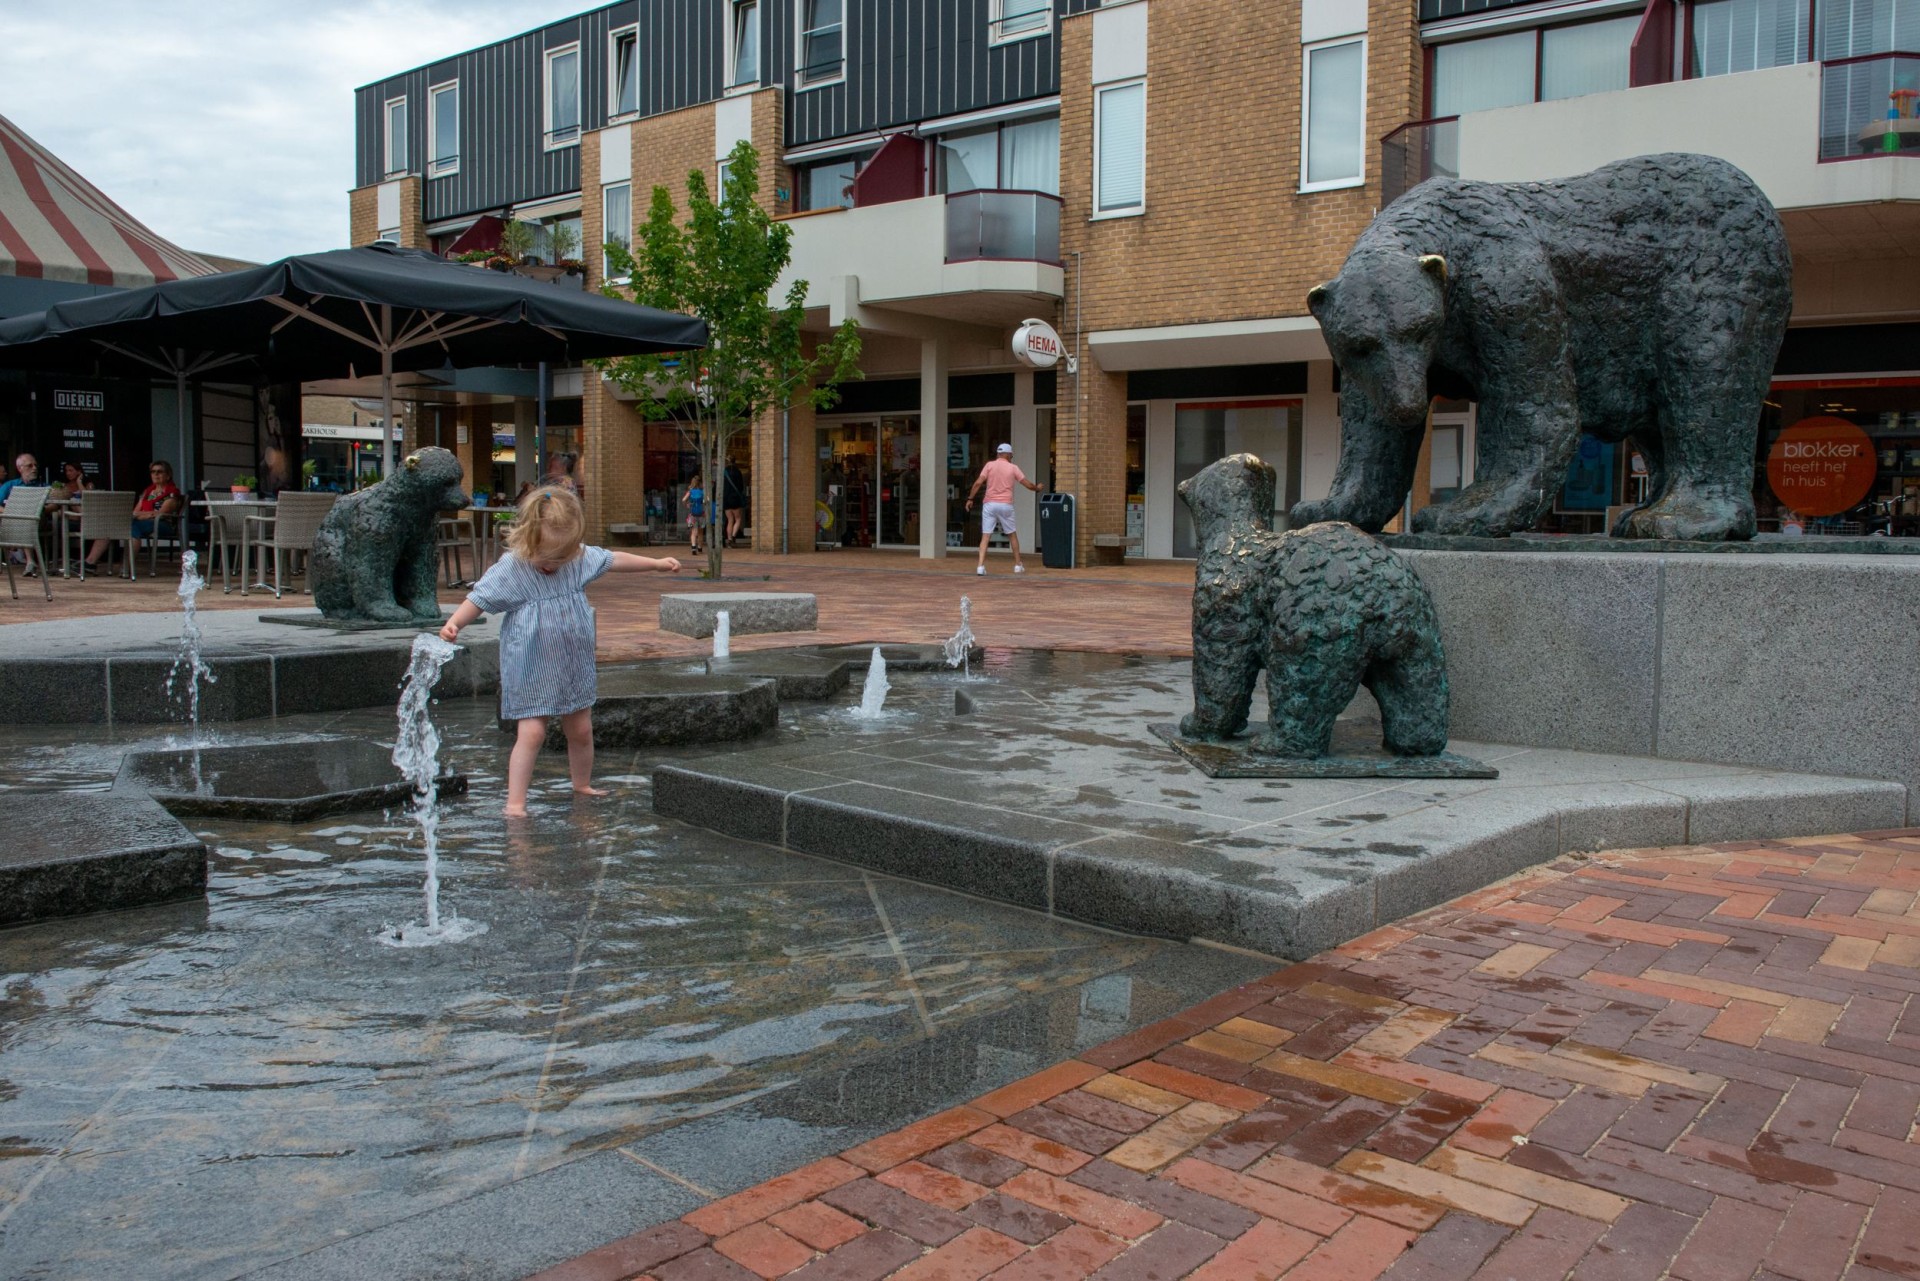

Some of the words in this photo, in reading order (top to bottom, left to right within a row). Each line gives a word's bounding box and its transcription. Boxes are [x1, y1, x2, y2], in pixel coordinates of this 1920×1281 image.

[1028, 334, 1057, 353] HEMA
[58, 393, 100, 408] DIEREN
[63, 429, 77, 437] HIGH
[64, 440, 78, 448] HIGH
[79, 441, 94, 449] WINE
[1783, 460, 1819, 473] heeft
[1824, 460, 1848, 473] het
[1783, 475, 1794, 487] in
[1798, 475, 1827, 487] huis
